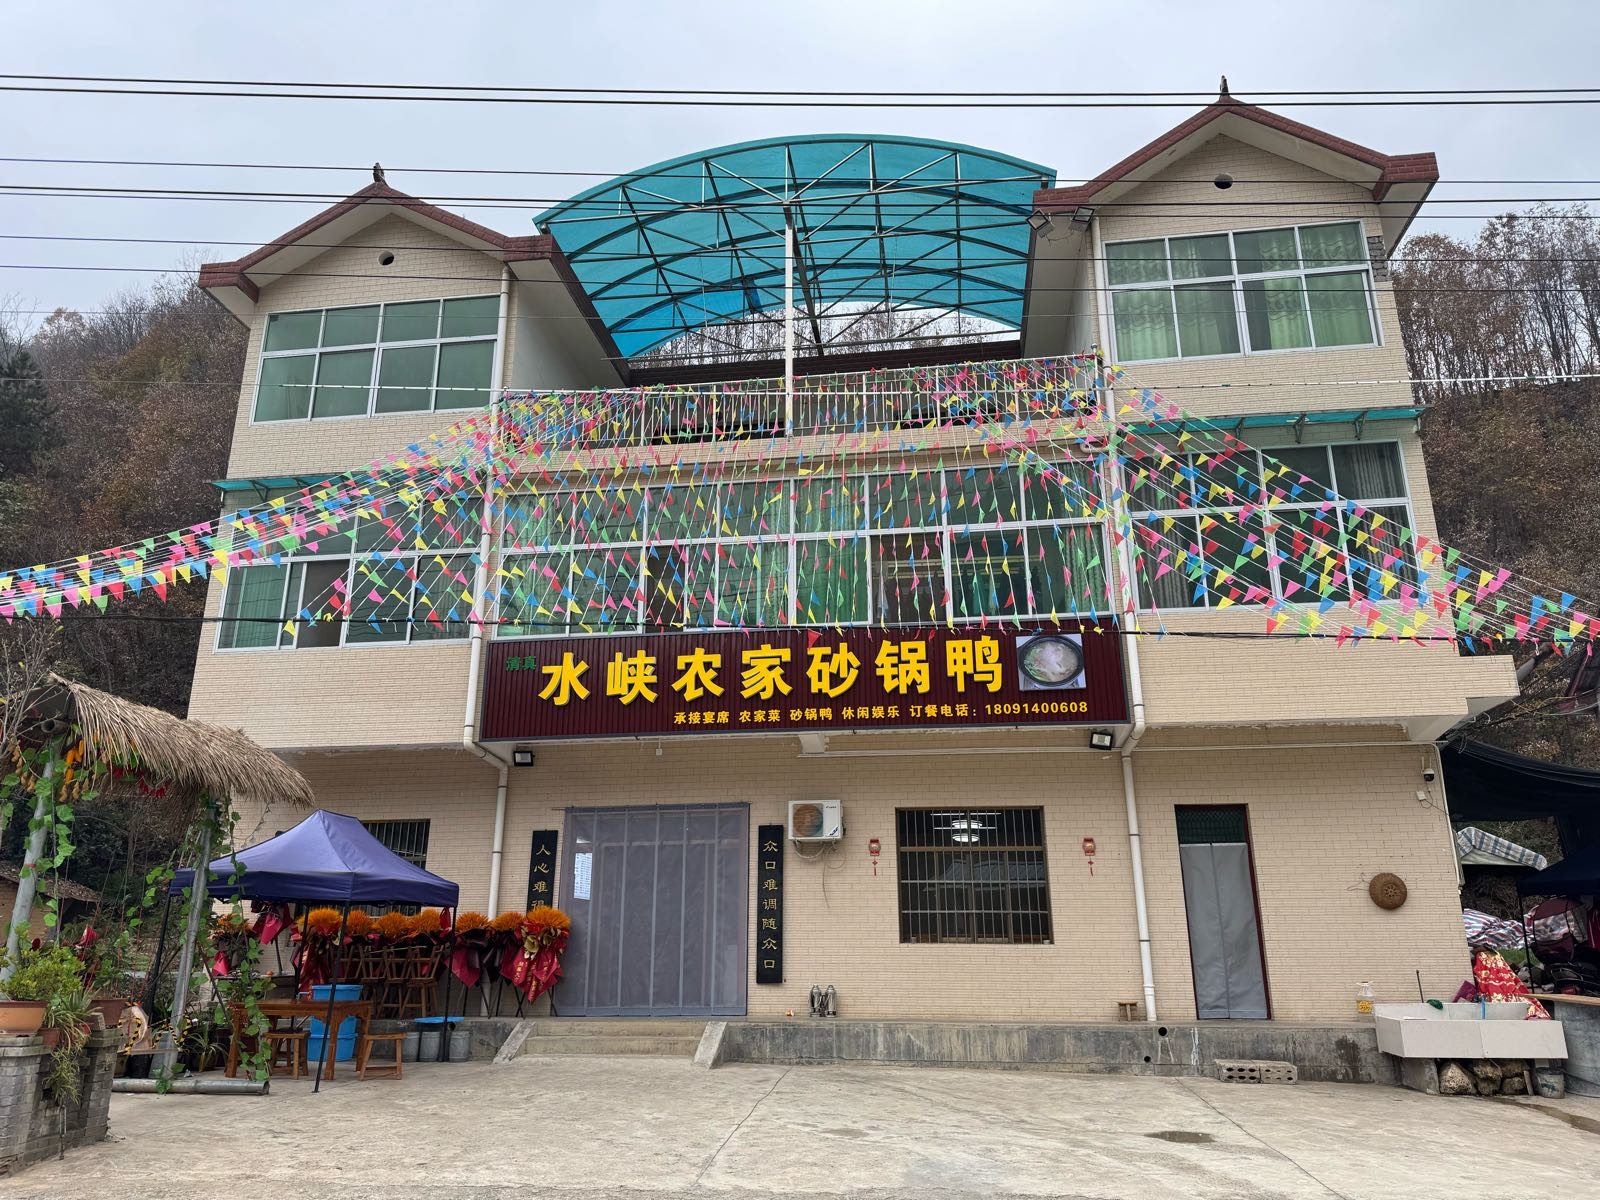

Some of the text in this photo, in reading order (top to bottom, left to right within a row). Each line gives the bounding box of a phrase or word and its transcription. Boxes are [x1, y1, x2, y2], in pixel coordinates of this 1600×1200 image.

[506, 655, 536, 671] 清真
[538, 635, 1003, 705] 水峡农家砂锅鸭
[673, 710, 730, 725] 承接宴席
[738, 709, 782, 723] 农家菜
[789, 707, 833, 722] 砂锅鸭
[841, 705, 900, 720] 休闲娱乐
[762, 840, 778, 969] 众口难调随众口
